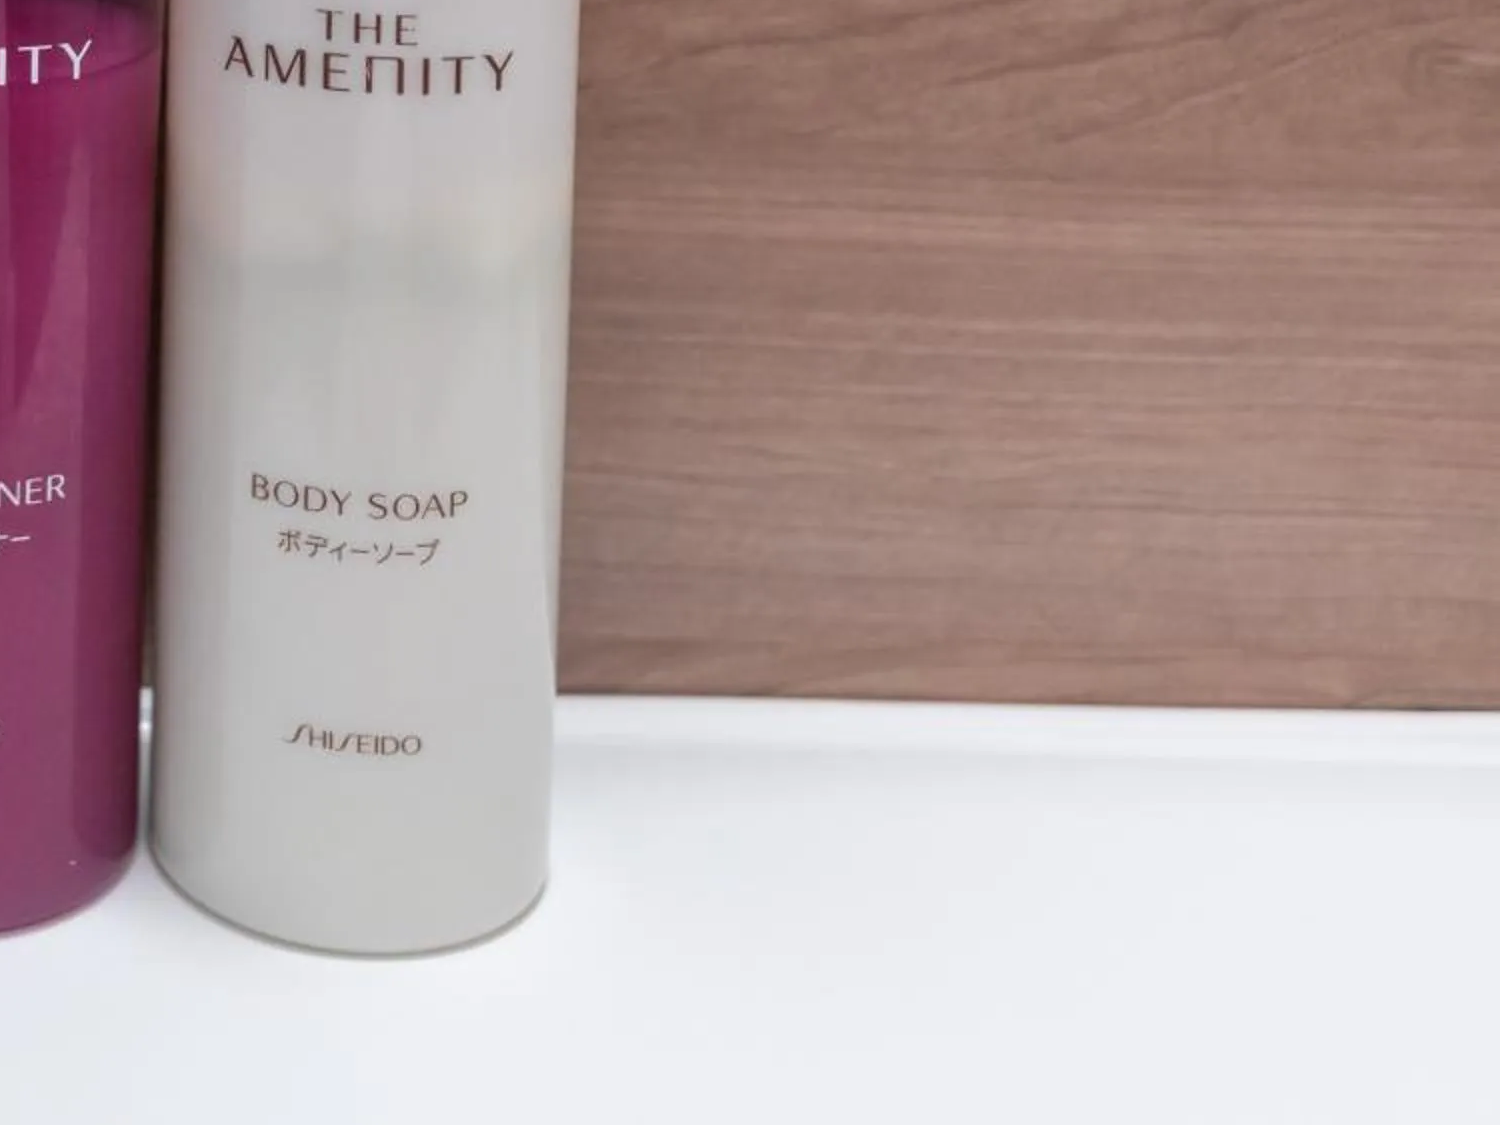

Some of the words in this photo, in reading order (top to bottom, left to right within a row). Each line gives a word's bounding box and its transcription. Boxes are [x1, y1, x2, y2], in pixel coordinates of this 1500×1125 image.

[314, 8, 419, 47] THE
[249, 472, 352, 516] BODY
[366, 489, 470, 522] SOAP
[277, 529, 441, 566] ボディーソープ
[284, 722, 424, 757] SHISEIDO
